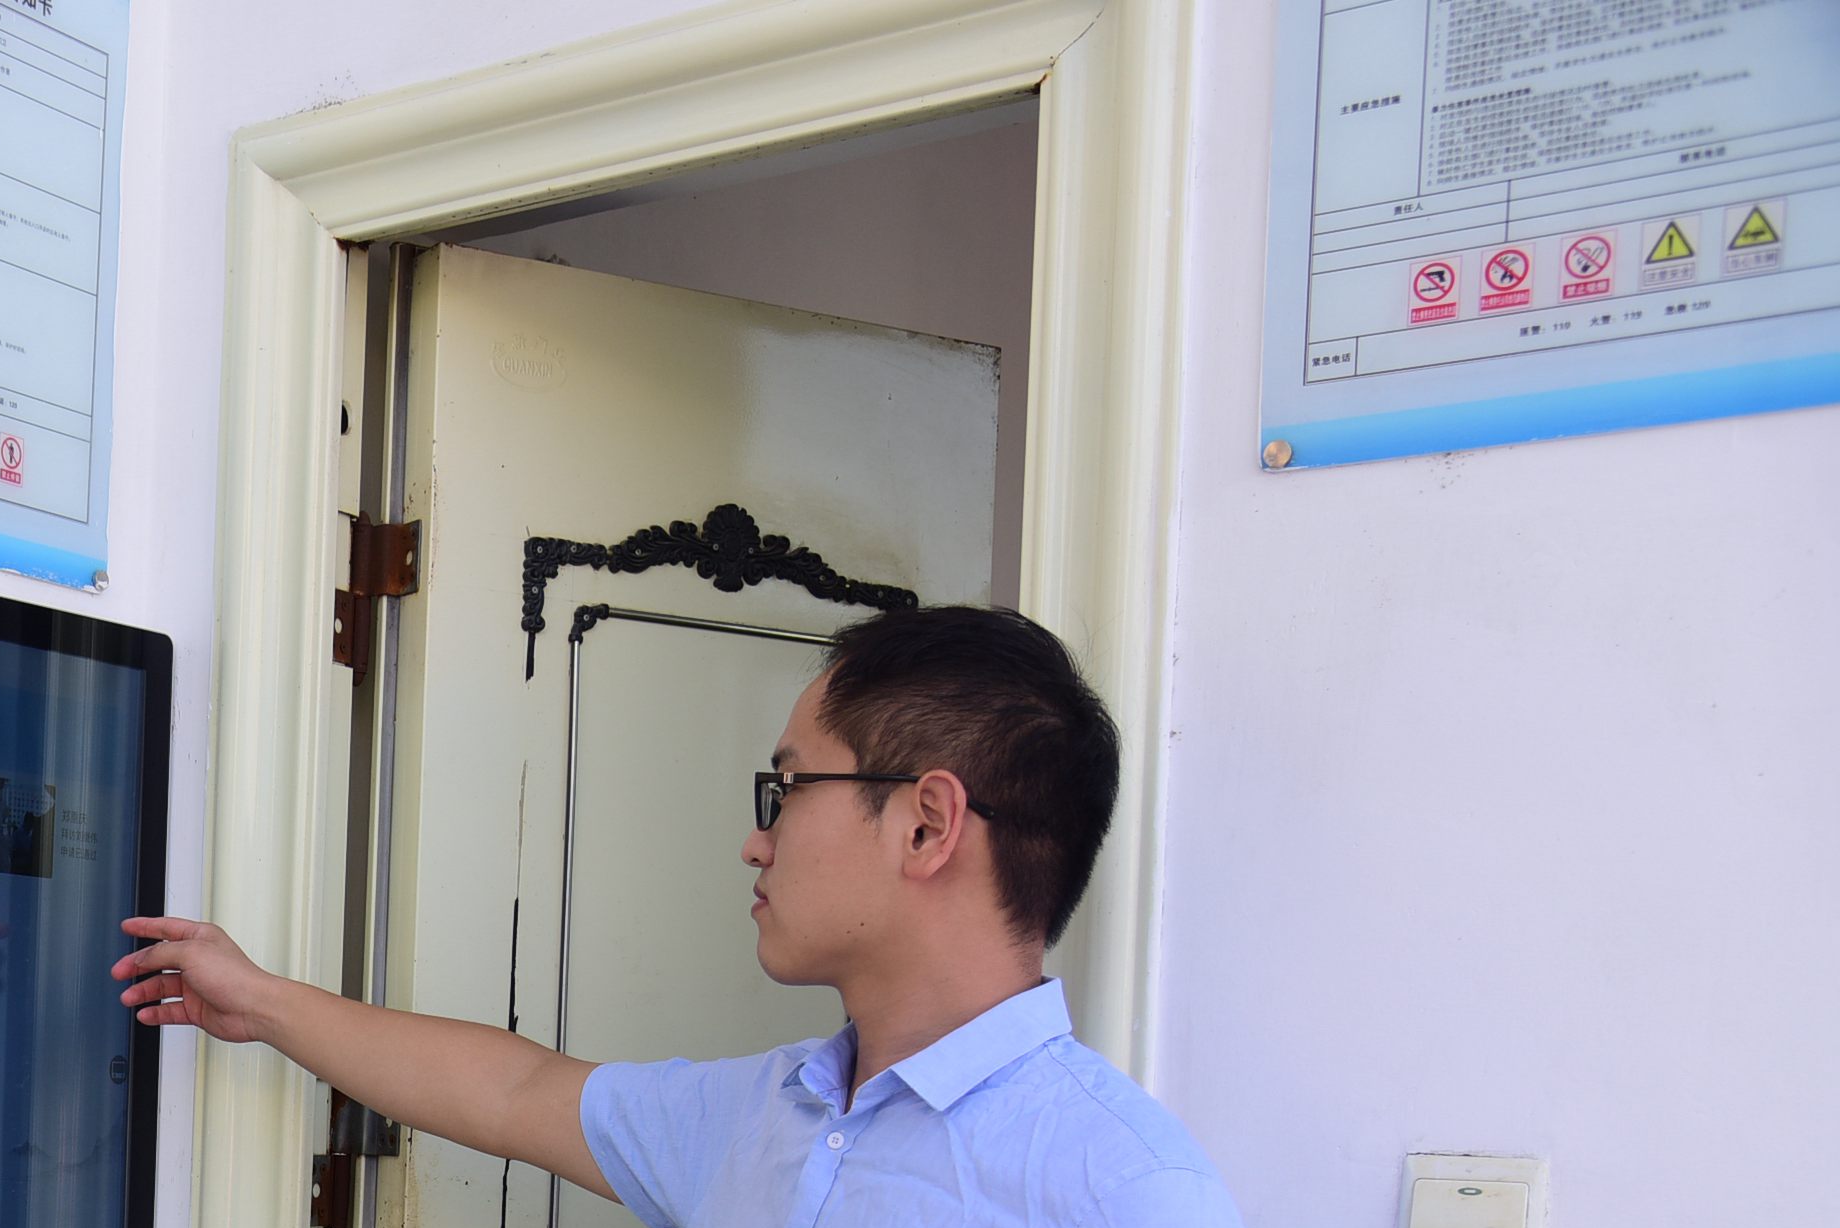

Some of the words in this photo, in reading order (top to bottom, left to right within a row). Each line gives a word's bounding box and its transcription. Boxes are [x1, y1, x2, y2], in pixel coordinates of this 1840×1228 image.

[1340, 95, 1402, 116] 主要应急措施
[1393, 202, 1424, 216] 责任人
[1311, 352, 1352, 369] 紧急电话
